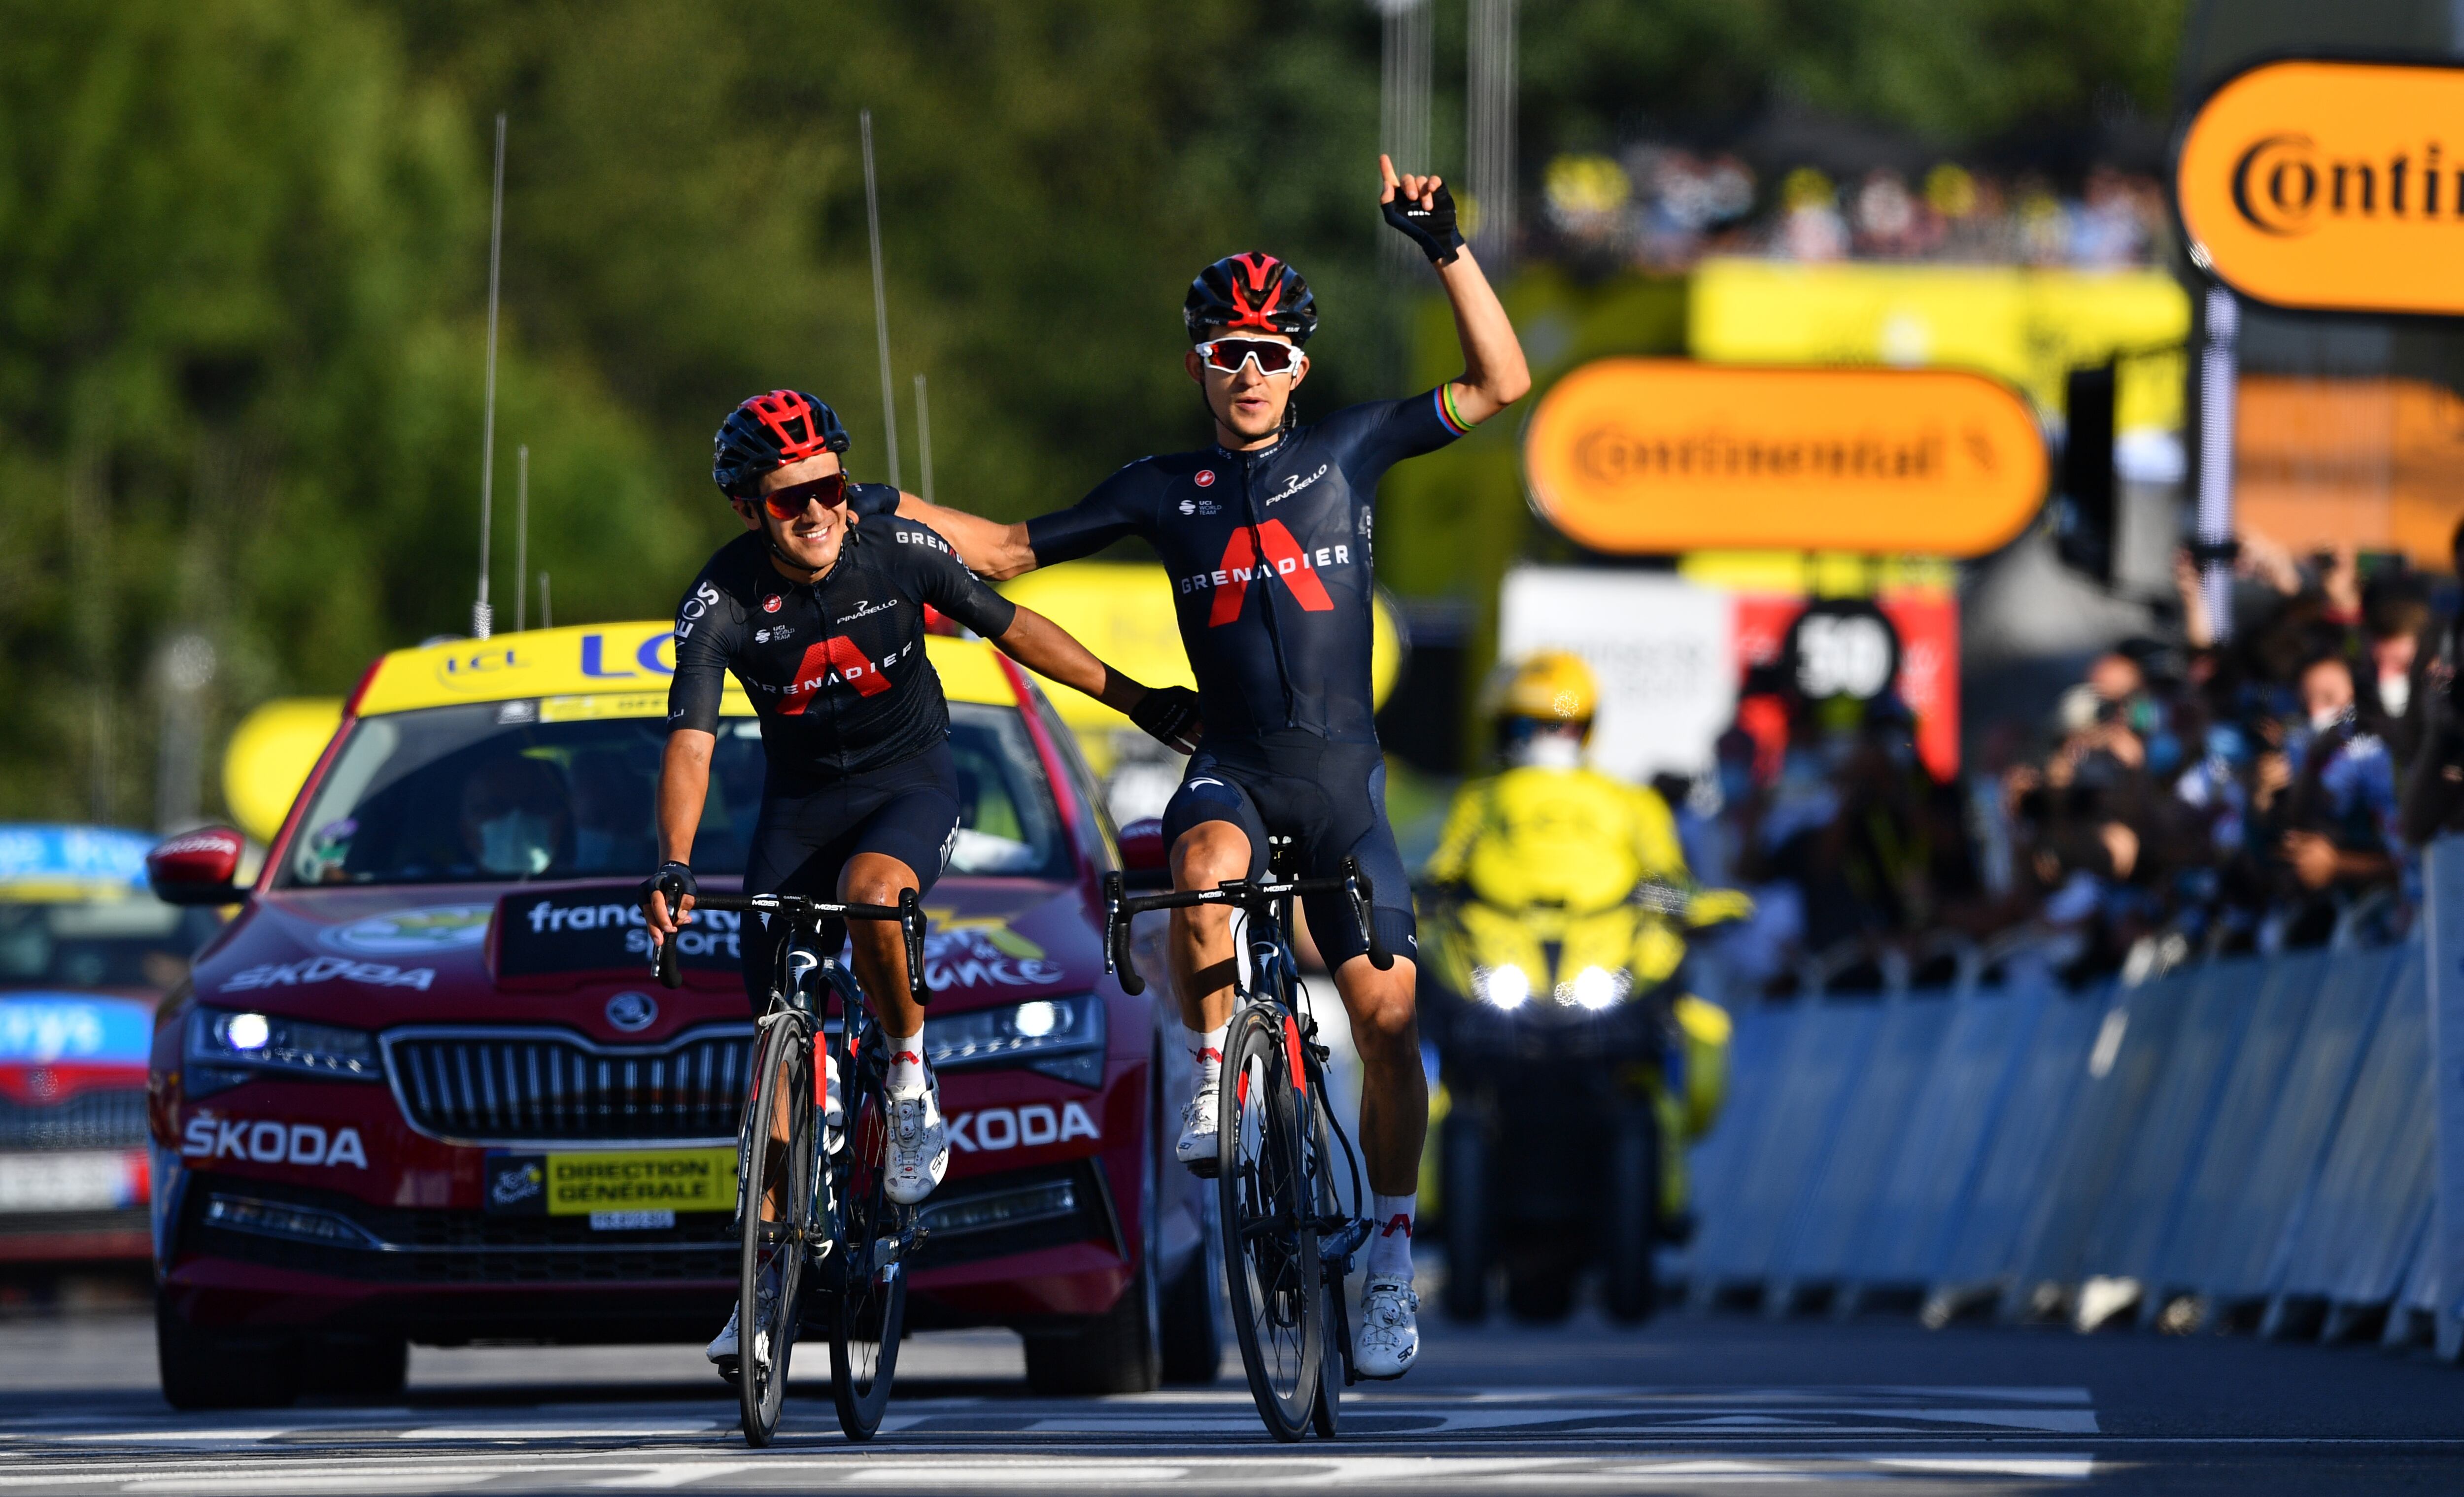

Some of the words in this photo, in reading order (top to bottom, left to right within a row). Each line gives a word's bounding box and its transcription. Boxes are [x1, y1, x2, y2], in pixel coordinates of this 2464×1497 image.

[1266, 464, 1327, 506] PINARELLO
[1182, 545, 1350, 594] GRENADIER
[837, 599, 897, 624] PINARELLO
[180, 1109, 368, 1170] ŠKODA
[944, 1101, 1101, 1154] KODA
[556, 1161, 710, 1180] DIRECTION
